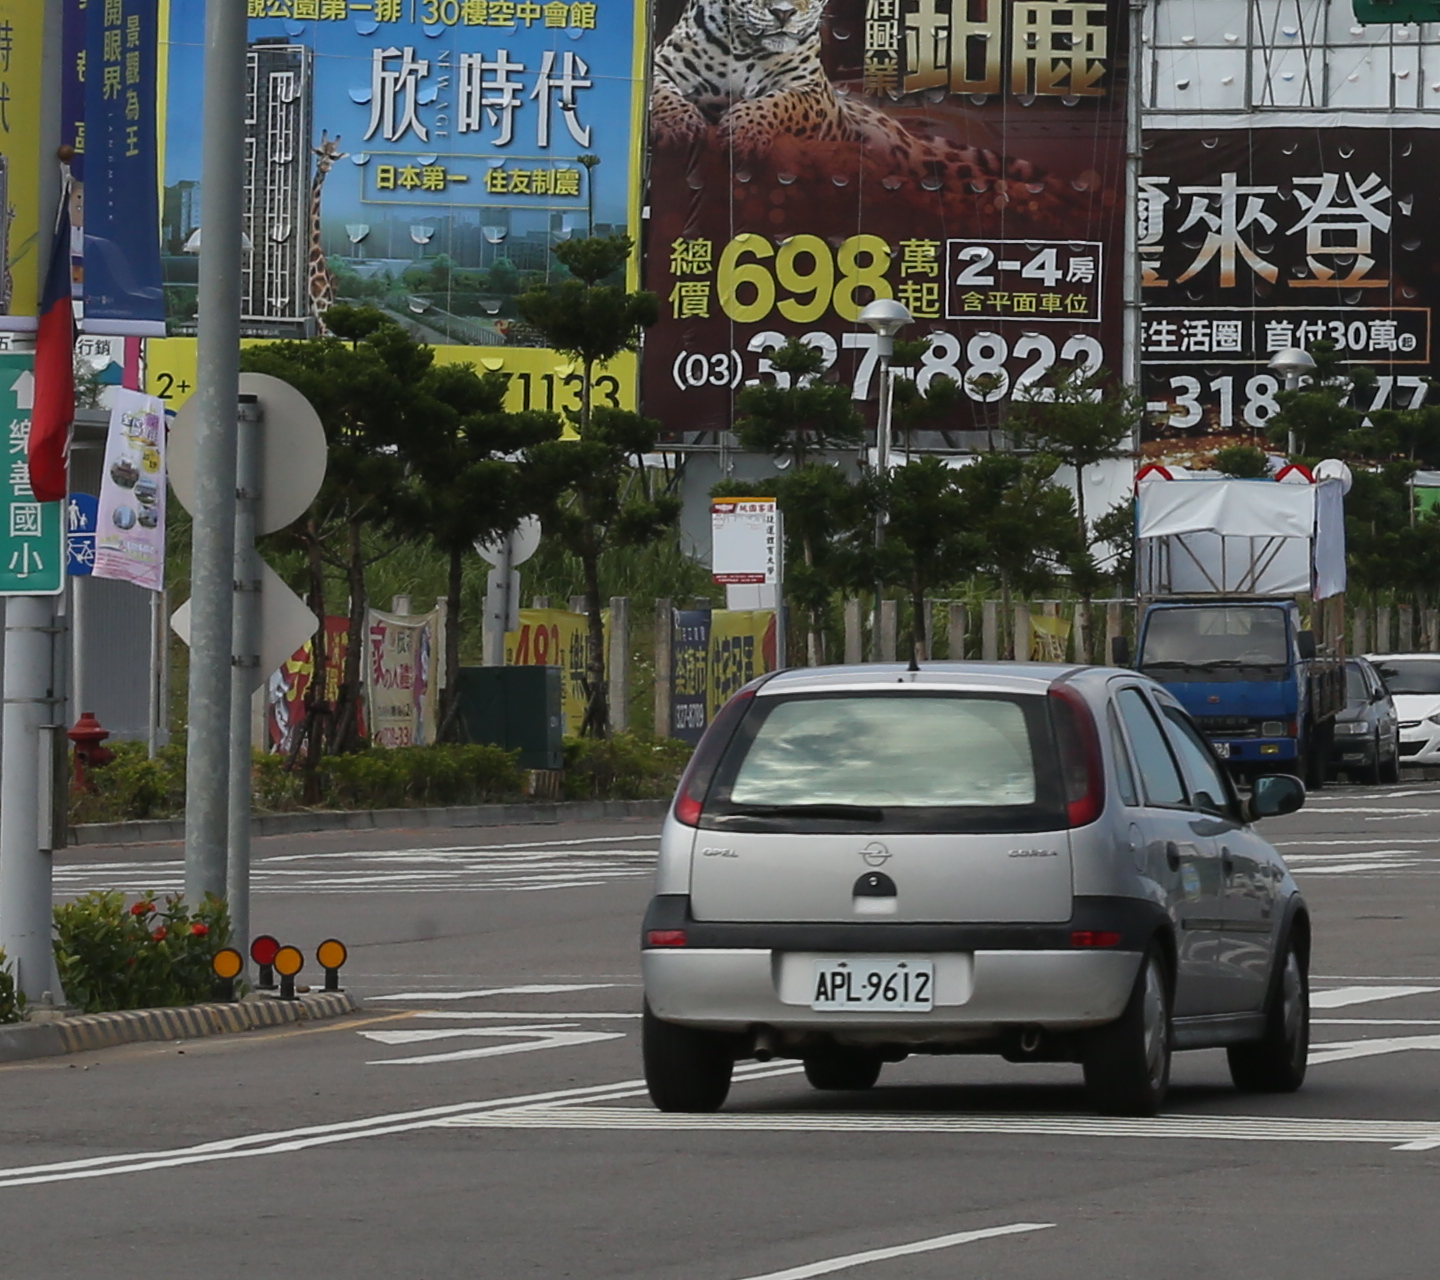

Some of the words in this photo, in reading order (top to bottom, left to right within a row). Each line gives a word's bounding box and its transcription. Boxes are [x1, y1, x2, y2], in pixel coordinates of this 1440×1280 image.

[125, 13, 141, 157] 景觀為王
[363, 46, 593, 148] 欣時代
[376, 164, 468, 191] 日本第一
[483, 168, 580, 196] 住友制震
[669, 237, 713, 320] 總價
[717, 233, 892, 323] 698
[899, 237, 941, 320] 萬起
[956, 246, 1096, 287] 2-4房
[961, 289, 1091, 316] 含平面車位
[702, 847, 740, 858] OPEL
[1007, 848, 1059, 858] CORSA
[814, 970, 931, 1003] APL-9612
